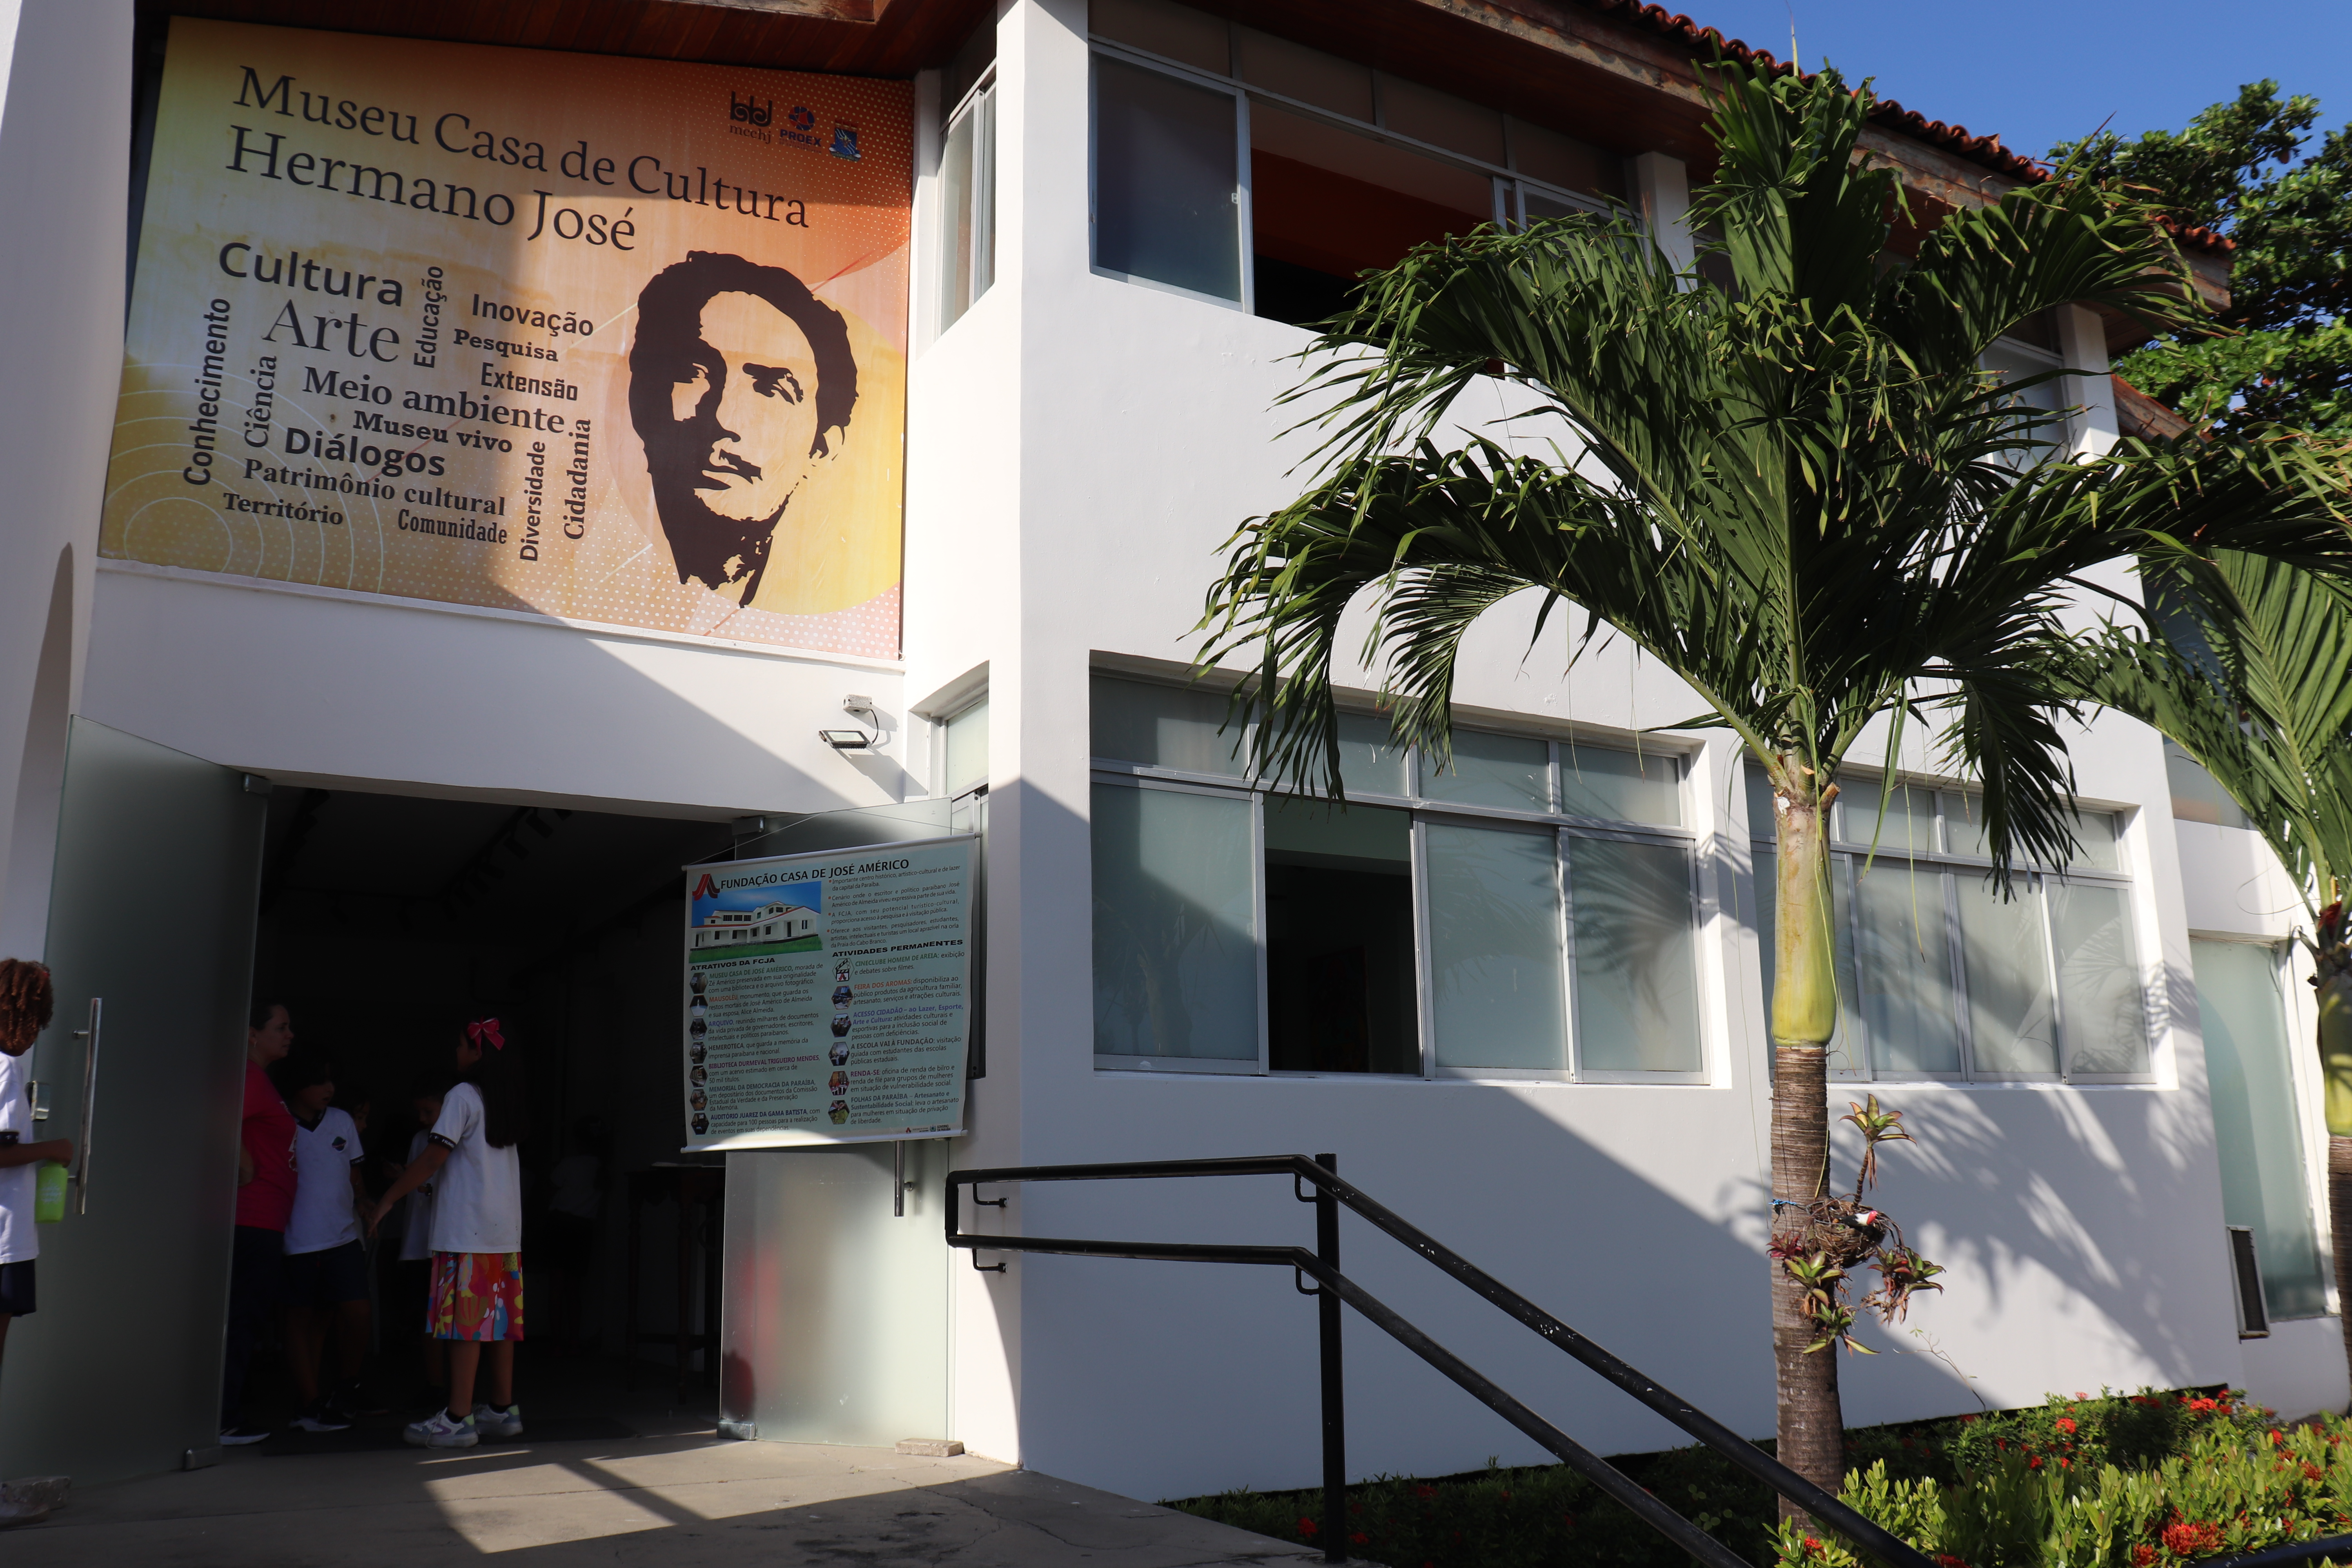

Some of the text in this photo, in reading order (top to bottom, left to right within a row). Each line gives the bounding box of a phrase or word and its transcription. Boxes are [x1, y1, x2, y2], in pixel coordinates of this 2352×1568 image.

[730, 126, 770, 144] mcchj
[780, 129, 821, 147] PROEX
[233, 65, 808, 227] Museu Casa de Cultura
[226, 125, 634, 250] Hermano José
[220, 243, 402, 307] Cultura
[414, 267, 447, 368] Educação
[473, 294, 593, 337] Inovação
[262, 299, 399, 362] Arte
[454, 329, 558, 361] Pesquisa
[481, 362, 577, 401] Extensão
[183, 299, 230, 485] Conhecimento
[303, 367, 565, 434] Meio ambiente
[244, 356, 276, 448] Ciência
[353, 410, 512, 452] Museu vivo
[285, 427, 445, 476] Diálogos
[243, 459, 505, 515] Patrimônio cultural
[563, 420, 590, 539] Cidadania
[223, 493, 343, 524] Território
[520, 442, 545, 561] Diversidade
[398, 509, 506, 544] Comunidade
[721, 859, 909, 889] FUNDAÇÃO CASA DE JOSÉ AMÉRICO
[832, 877, 858, 886] Importante
[922, 884, 946, 893] paraibano
[891, 893, 916, 902] expressiva
[882, 904, 908, 914] potencial
[831, 916, 860, 926] proporciona
[880, 912, 901, 920] pesquisa
[832, 940, 963, 957] ATIVIDADES PERMANENTES
[941, 950, 965, 958] exibição
[691, 962, 737, 971] ATRATIVOS
[737, 970, 816, 985] preservada originalidade
[913, 976, 949, 986] disponibiliza
[854, 991, 873, 999] público
[875, 988, 898, 997] produtos
[907, 984, 937, 993] agricultura
[876, 1007, 903, 1015] CIDADÃO
[740, 1031, 759, 1040] políticos
[852, 1025, 878, 1033] esportivas
[731, 1051, 755, 1059] paraibana
[851, 1058, 872, 1066] públicas
[890, 1081, 933, 1089] vulnerabilidade
[718, 1091, 744, 1100] depositário
[851, 1096, 959, 1110] Sustentabilidade artesanato
[895, 1107, 918, 1116] situação
[927, 1105, 948, 1114] privação
[711, 1115, 818, 1129] capacidade realização
